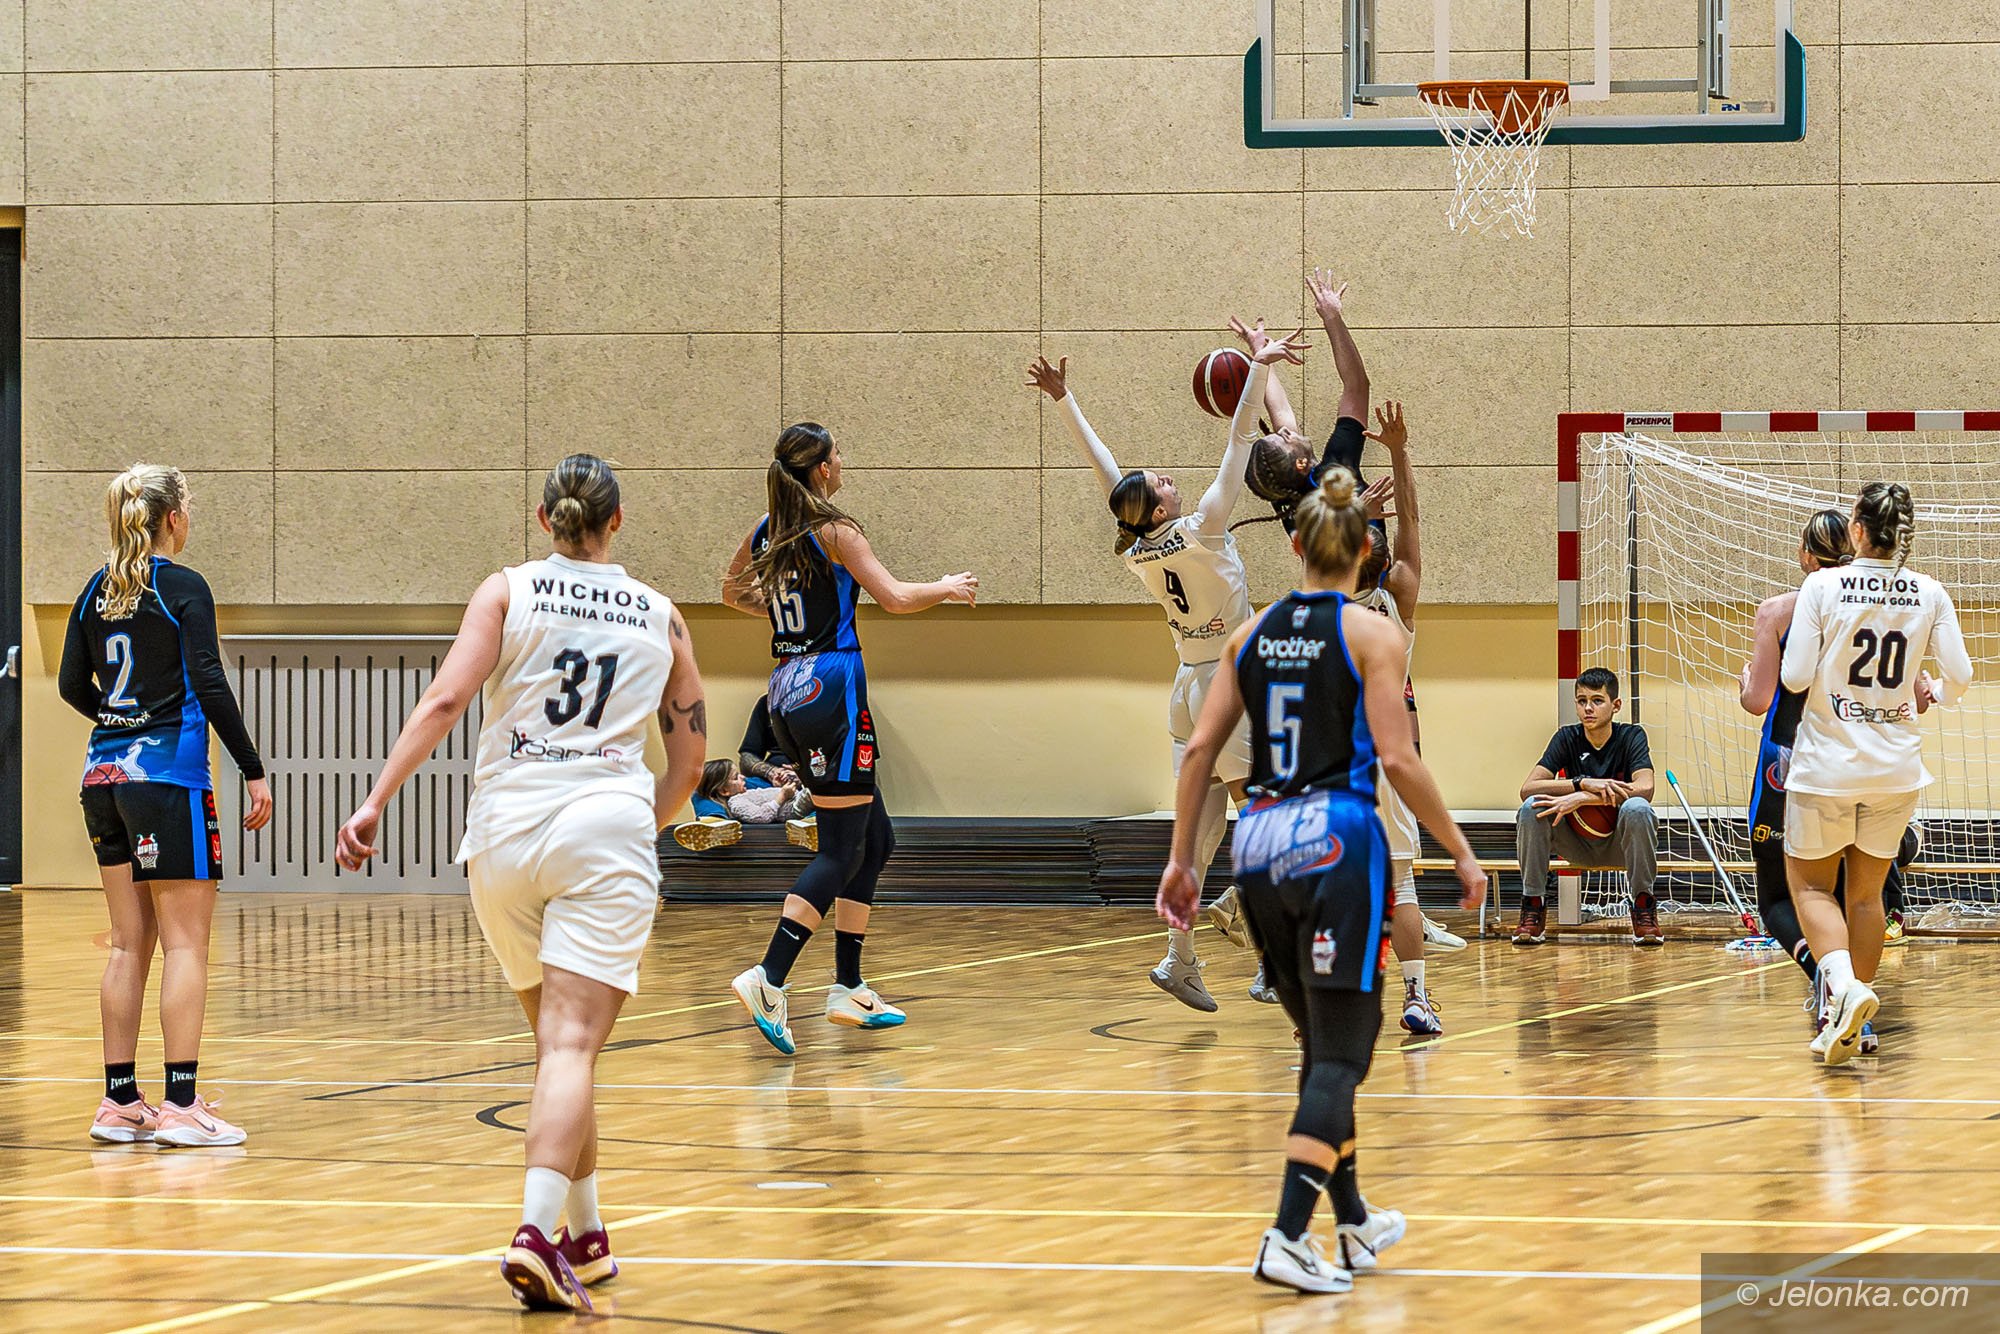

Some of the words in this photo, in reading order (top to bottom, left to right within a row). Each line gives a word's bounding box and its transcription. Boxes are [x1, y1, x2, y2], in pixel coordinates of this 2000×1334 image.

[1626, 417, 1672, 425] PESMENPOL
[532, 578, 650, 612] WICHOŚ
[773, 570, 805, 633] 15
[1162, 567, 1190, 615] 9
[1840, 594, 1887, 606] JELENIA
[1889, 596, 1921, 607] GÓRA
[532, 601, 598, 621] JELENIA
[604, 611, 648, 630] GÓRA
[106, 632, 138, 708] 2
[1258, 635, 1326, 660] brother
[1847, 628, 1908, 689] 20
[544, 648, 619, 730] 31
[1268, 683, 1305, 779] 5
